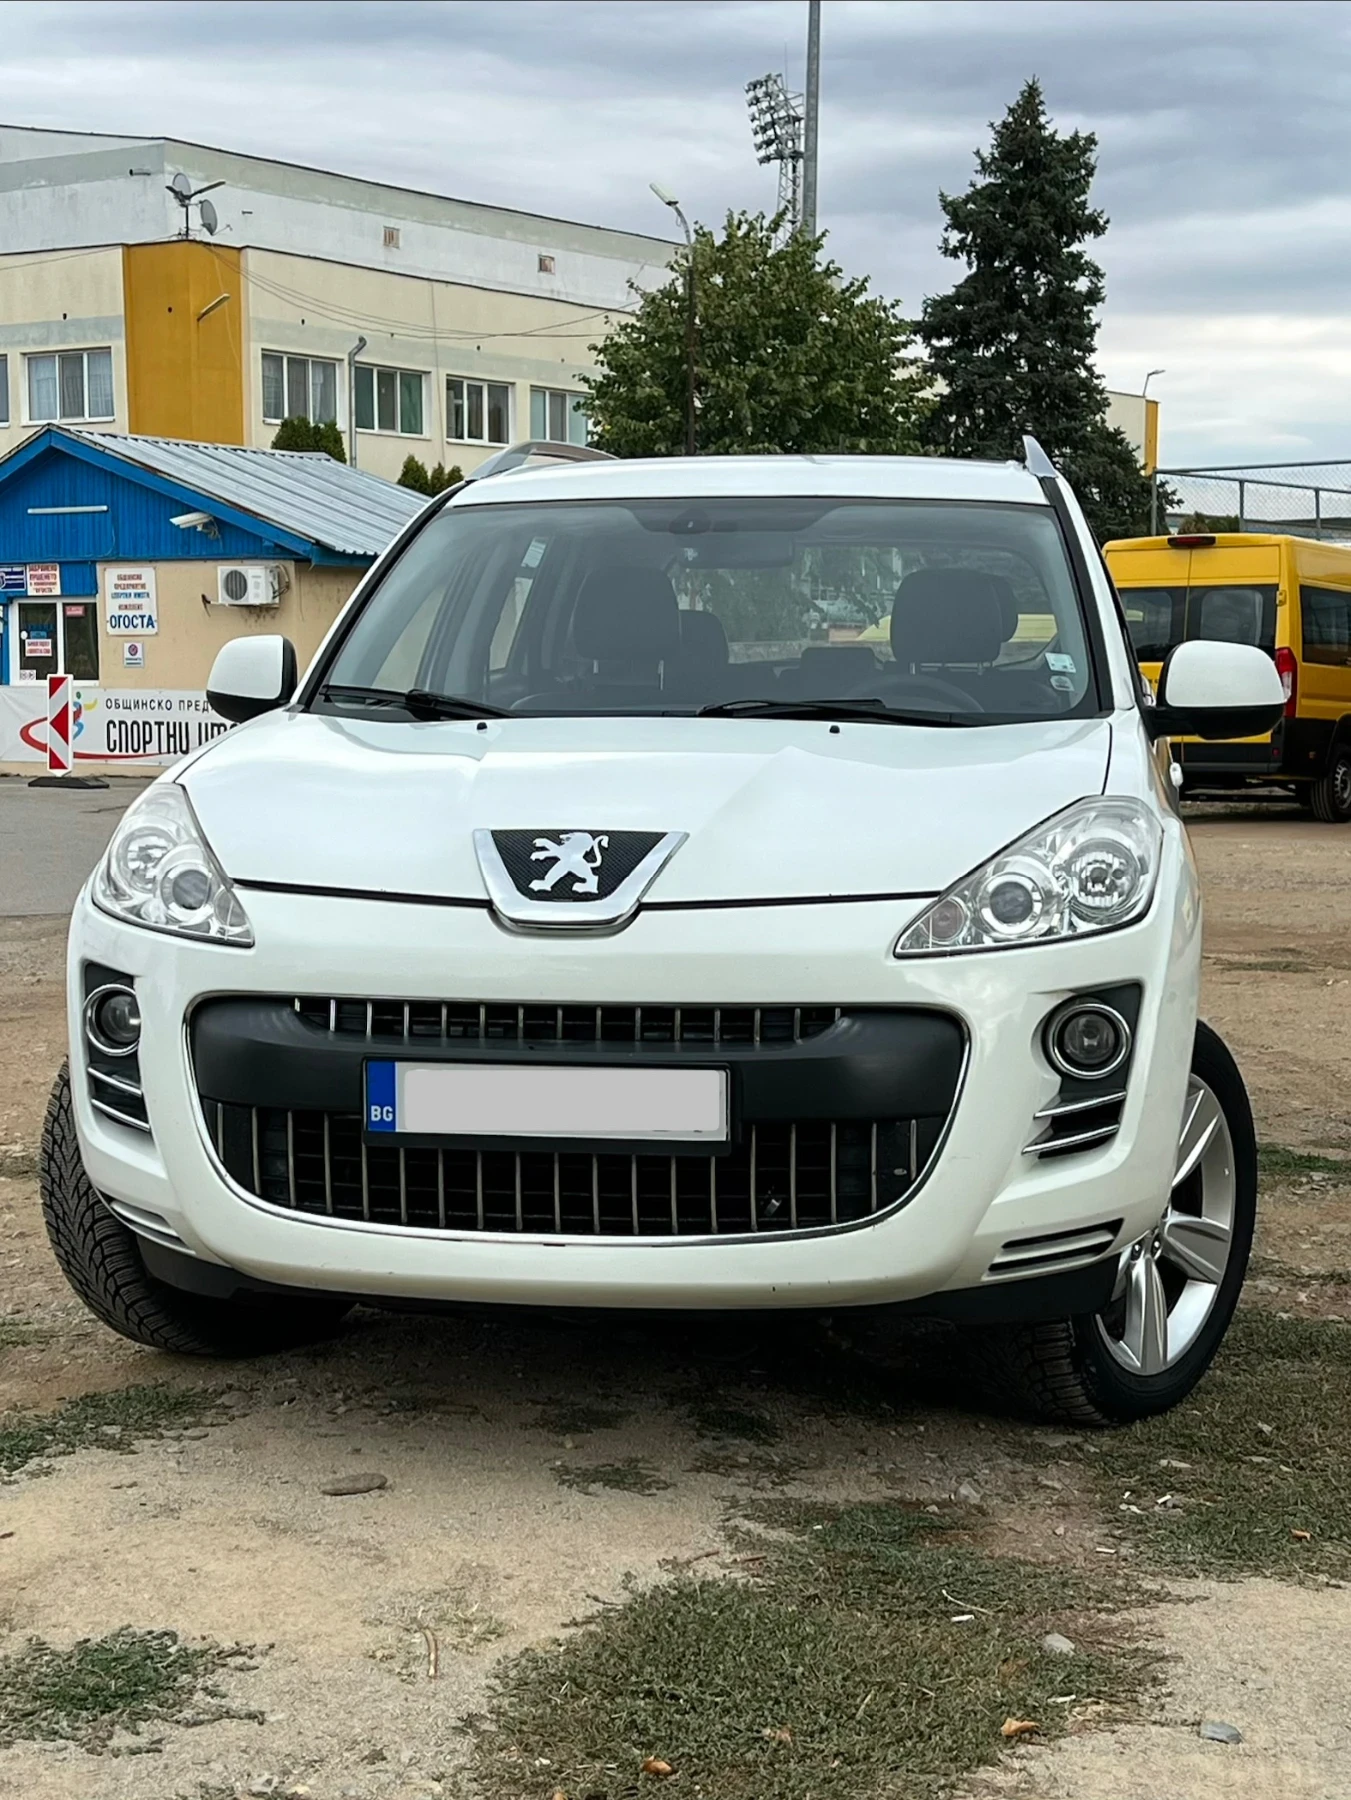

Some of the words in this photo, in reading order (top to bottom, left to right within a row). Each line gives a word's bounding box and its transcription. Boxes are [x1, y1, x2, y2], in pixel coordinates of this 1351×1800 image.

[109, 614, 155, 629] ОГОСТА
[105, 698, 173, 711] ОБЩИНСКО
[178, 699, 213, 713] ПРЕД
[106, 719, 190, 755] СПОРТНИ
[370, 1106, 393, 1122] BG
